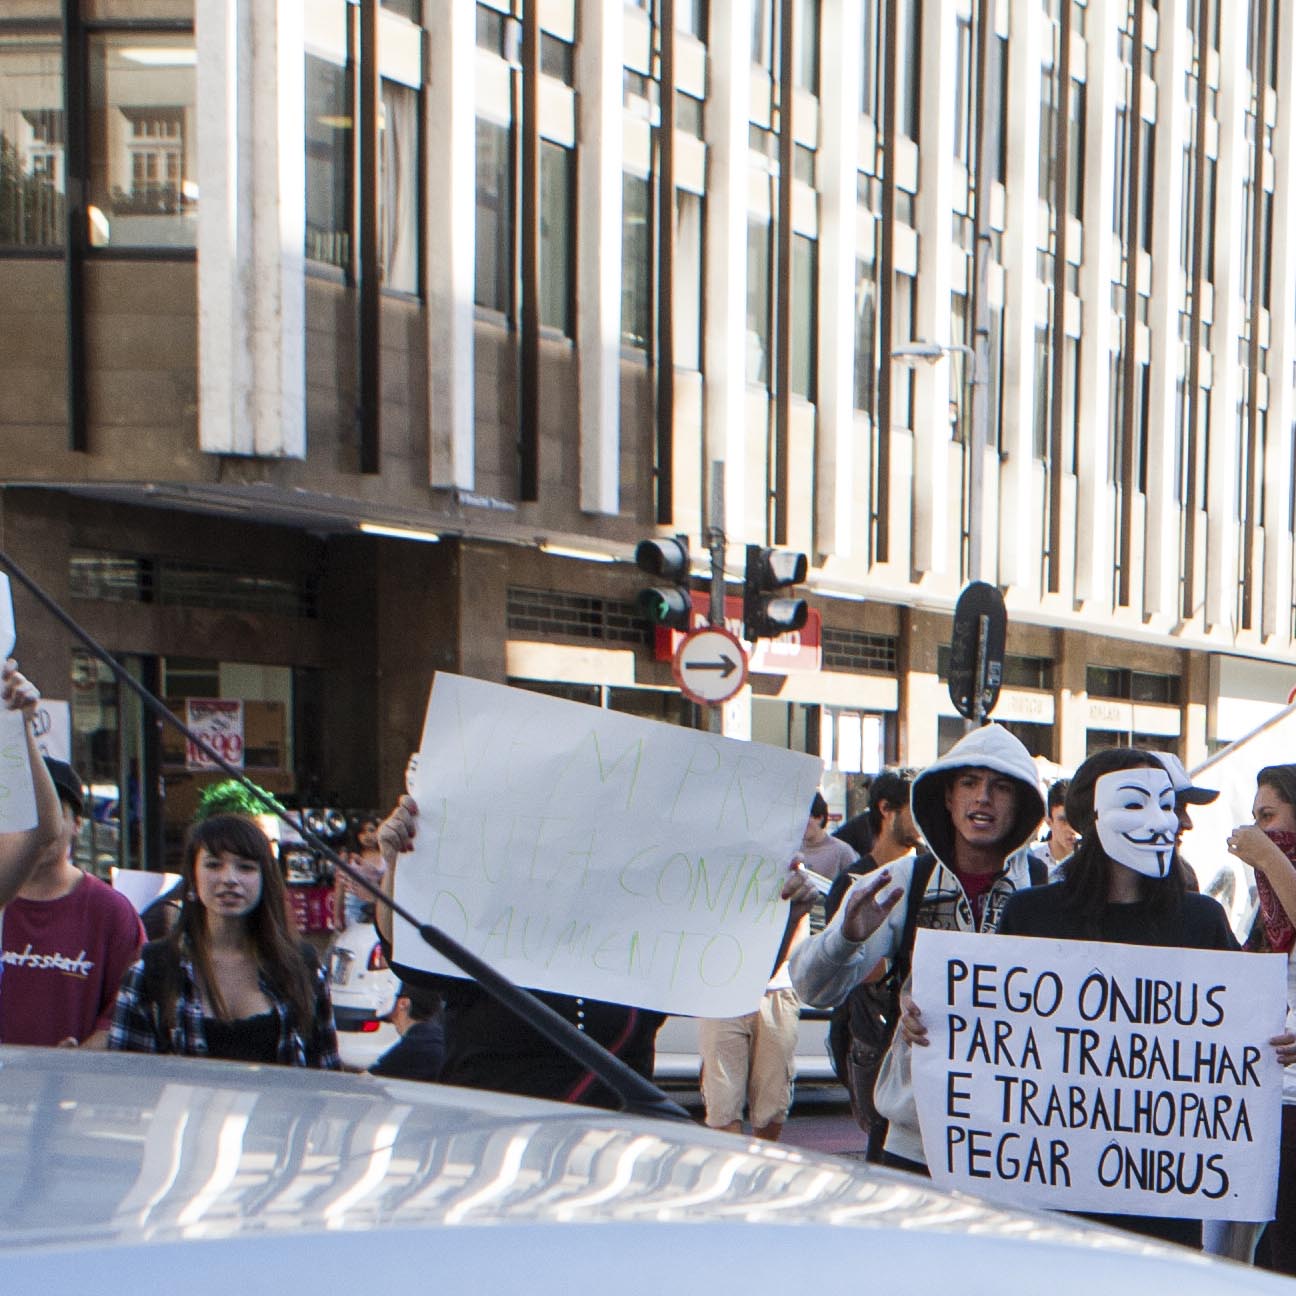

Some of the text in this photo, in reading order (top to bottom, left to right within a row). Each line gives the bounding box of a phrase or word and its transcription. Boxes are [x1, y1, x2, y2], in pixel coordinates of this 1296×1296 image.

[434, 798, 787, 925] LUTA CONTRA
[482, 904, 744, 990] AUMENTO
[947, 959, 1227, 1027] PEGO ÔNIBUS
[947, 1014, 1262, 1087] PARA TRABALHAR
[947, 1071, 972, 1119] E
[947, 1126, 1239, 1199] PEGAR ÔNIBUS.
